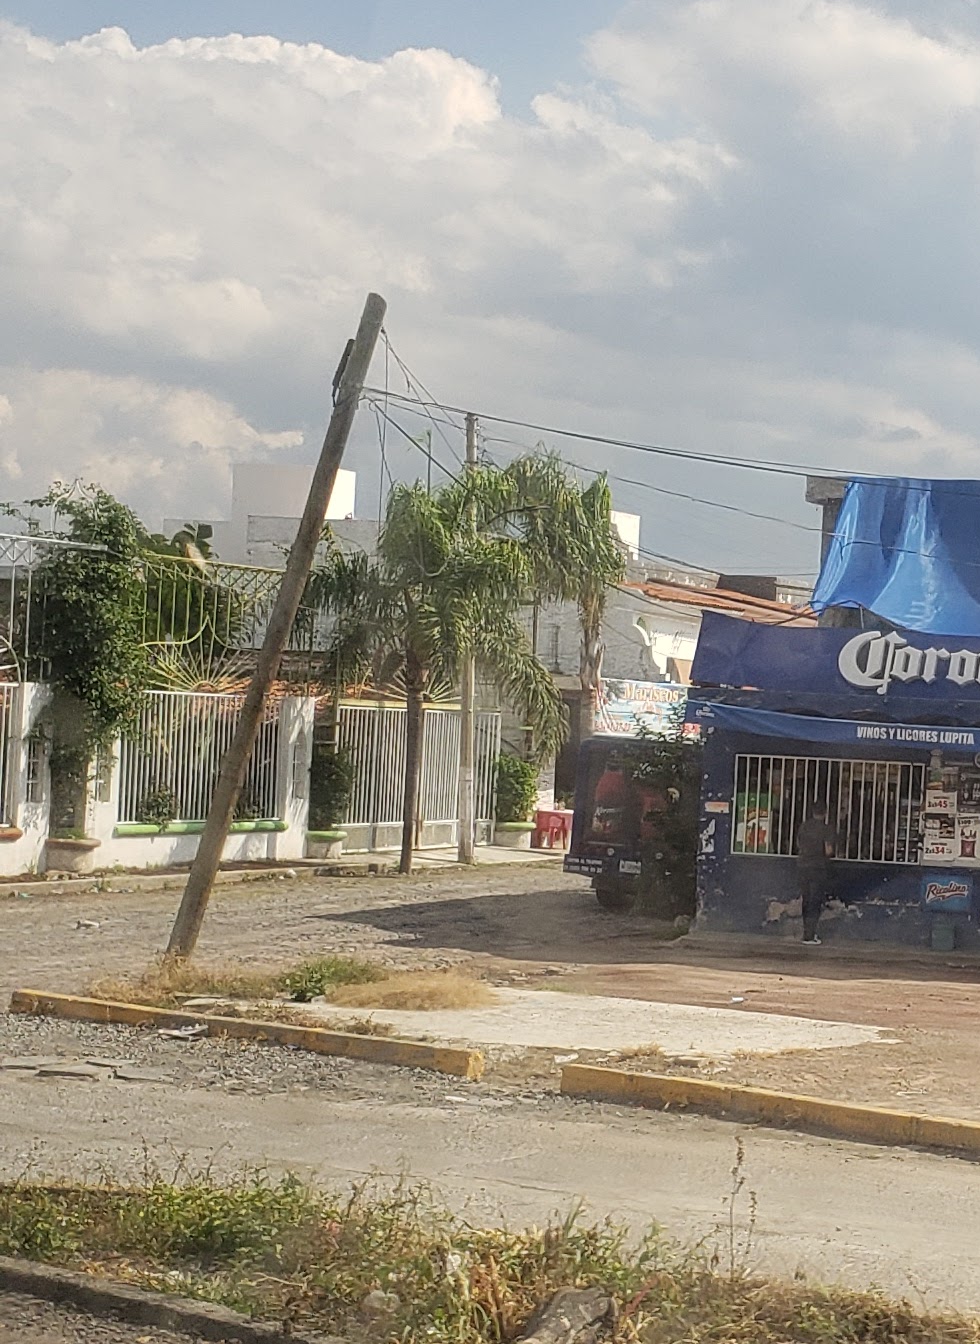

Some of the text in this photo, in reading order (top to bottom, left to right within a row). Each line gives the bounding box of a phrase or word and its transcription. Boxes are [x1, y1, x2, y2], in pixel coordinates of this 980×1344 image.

[623, 683, 679, 703] Mariscos
[857, 726, 975, 745] VINOS Y LICORES LUPITA
